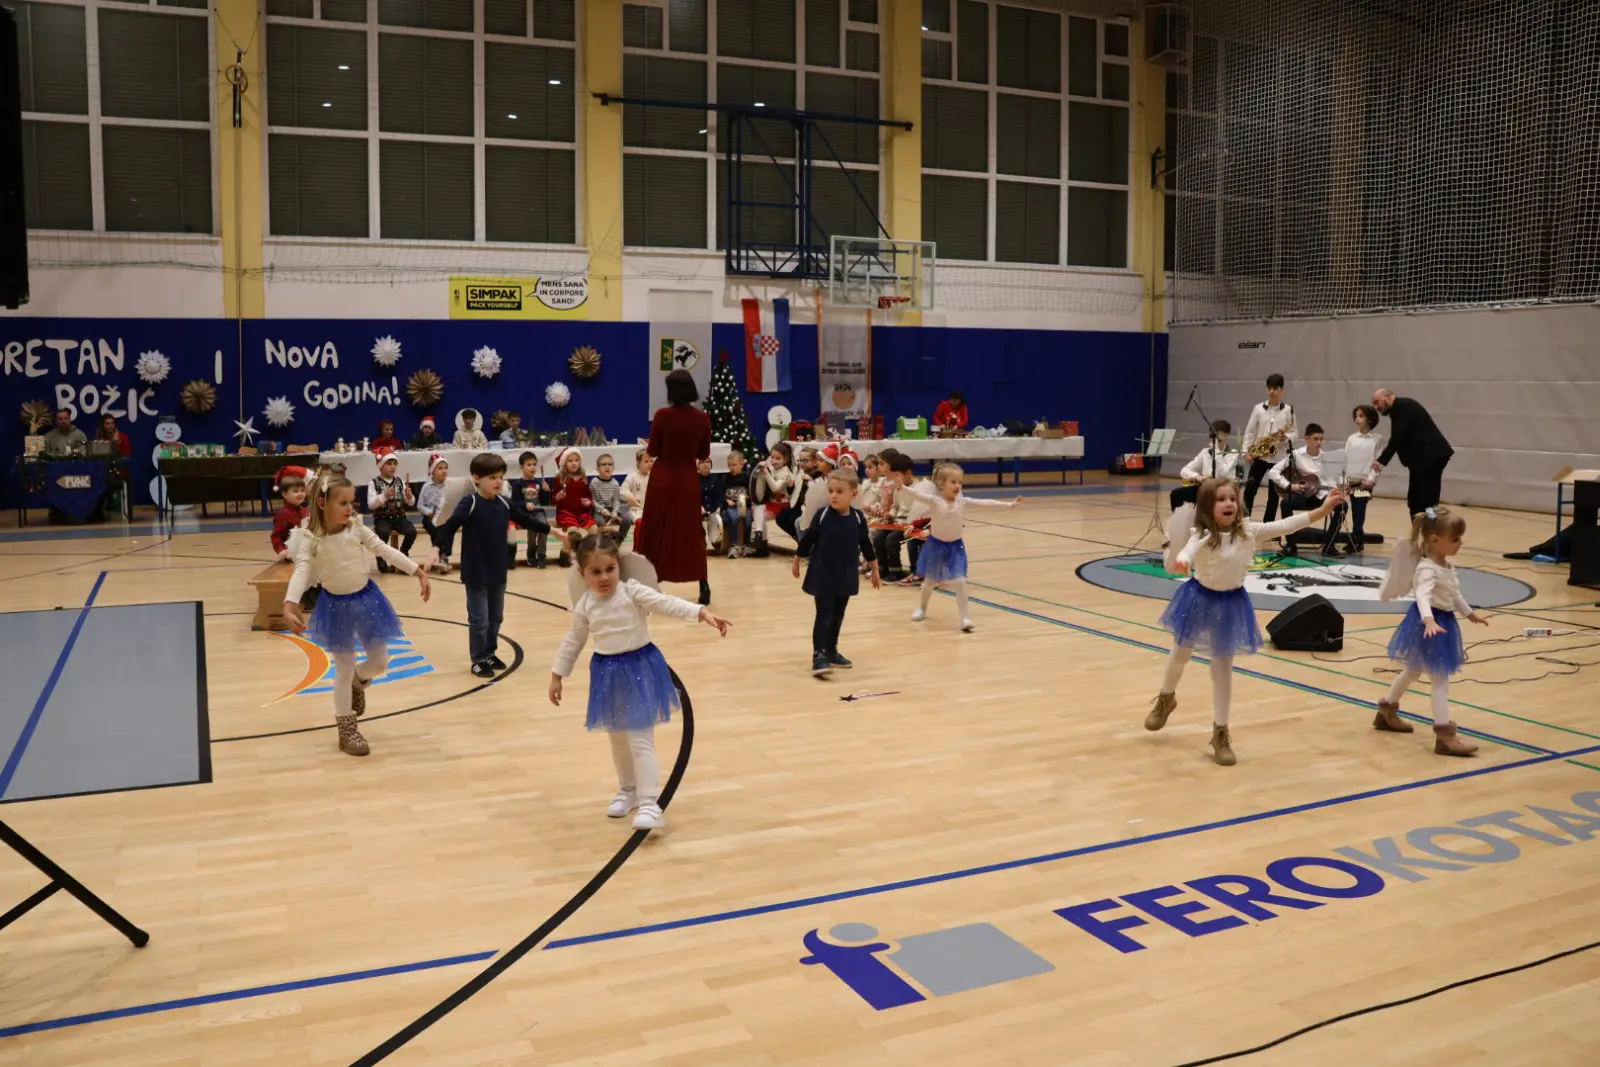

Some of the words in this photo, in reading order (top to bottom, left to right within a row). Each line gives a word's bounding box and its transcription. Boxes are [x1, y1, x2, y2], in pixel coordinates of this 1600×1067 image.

[469, 288, 517, 300] SIMPAK
[0, 337, 125, 378] RETAN
[264, 338, 339, 369] NOVA
[1237, 340, 1266, 349] elan
[303, 376, 401, 410] GODINA!
